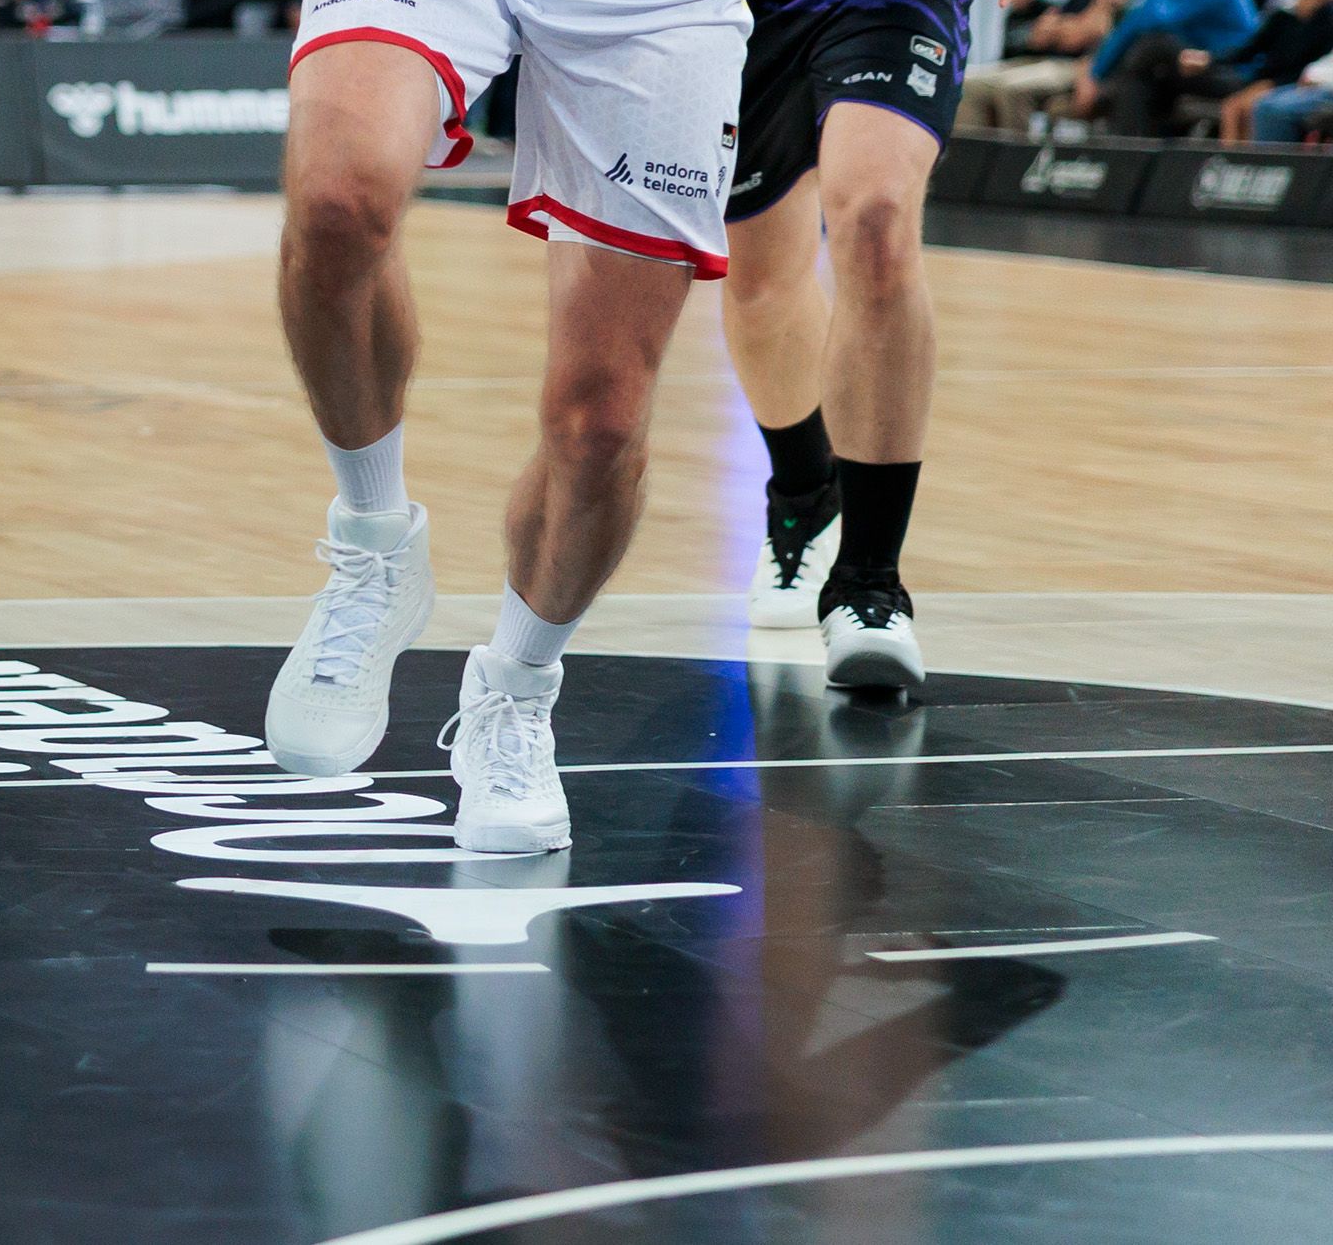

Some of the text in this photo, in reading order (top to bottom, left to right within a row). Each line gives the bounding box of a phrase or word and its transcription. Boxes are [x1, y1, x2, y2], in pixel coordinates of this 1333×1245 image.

[117, 80, 290, 137] humme
[645, 161, 709, 183] andorra
[643, 176, 708, 199] telecom
